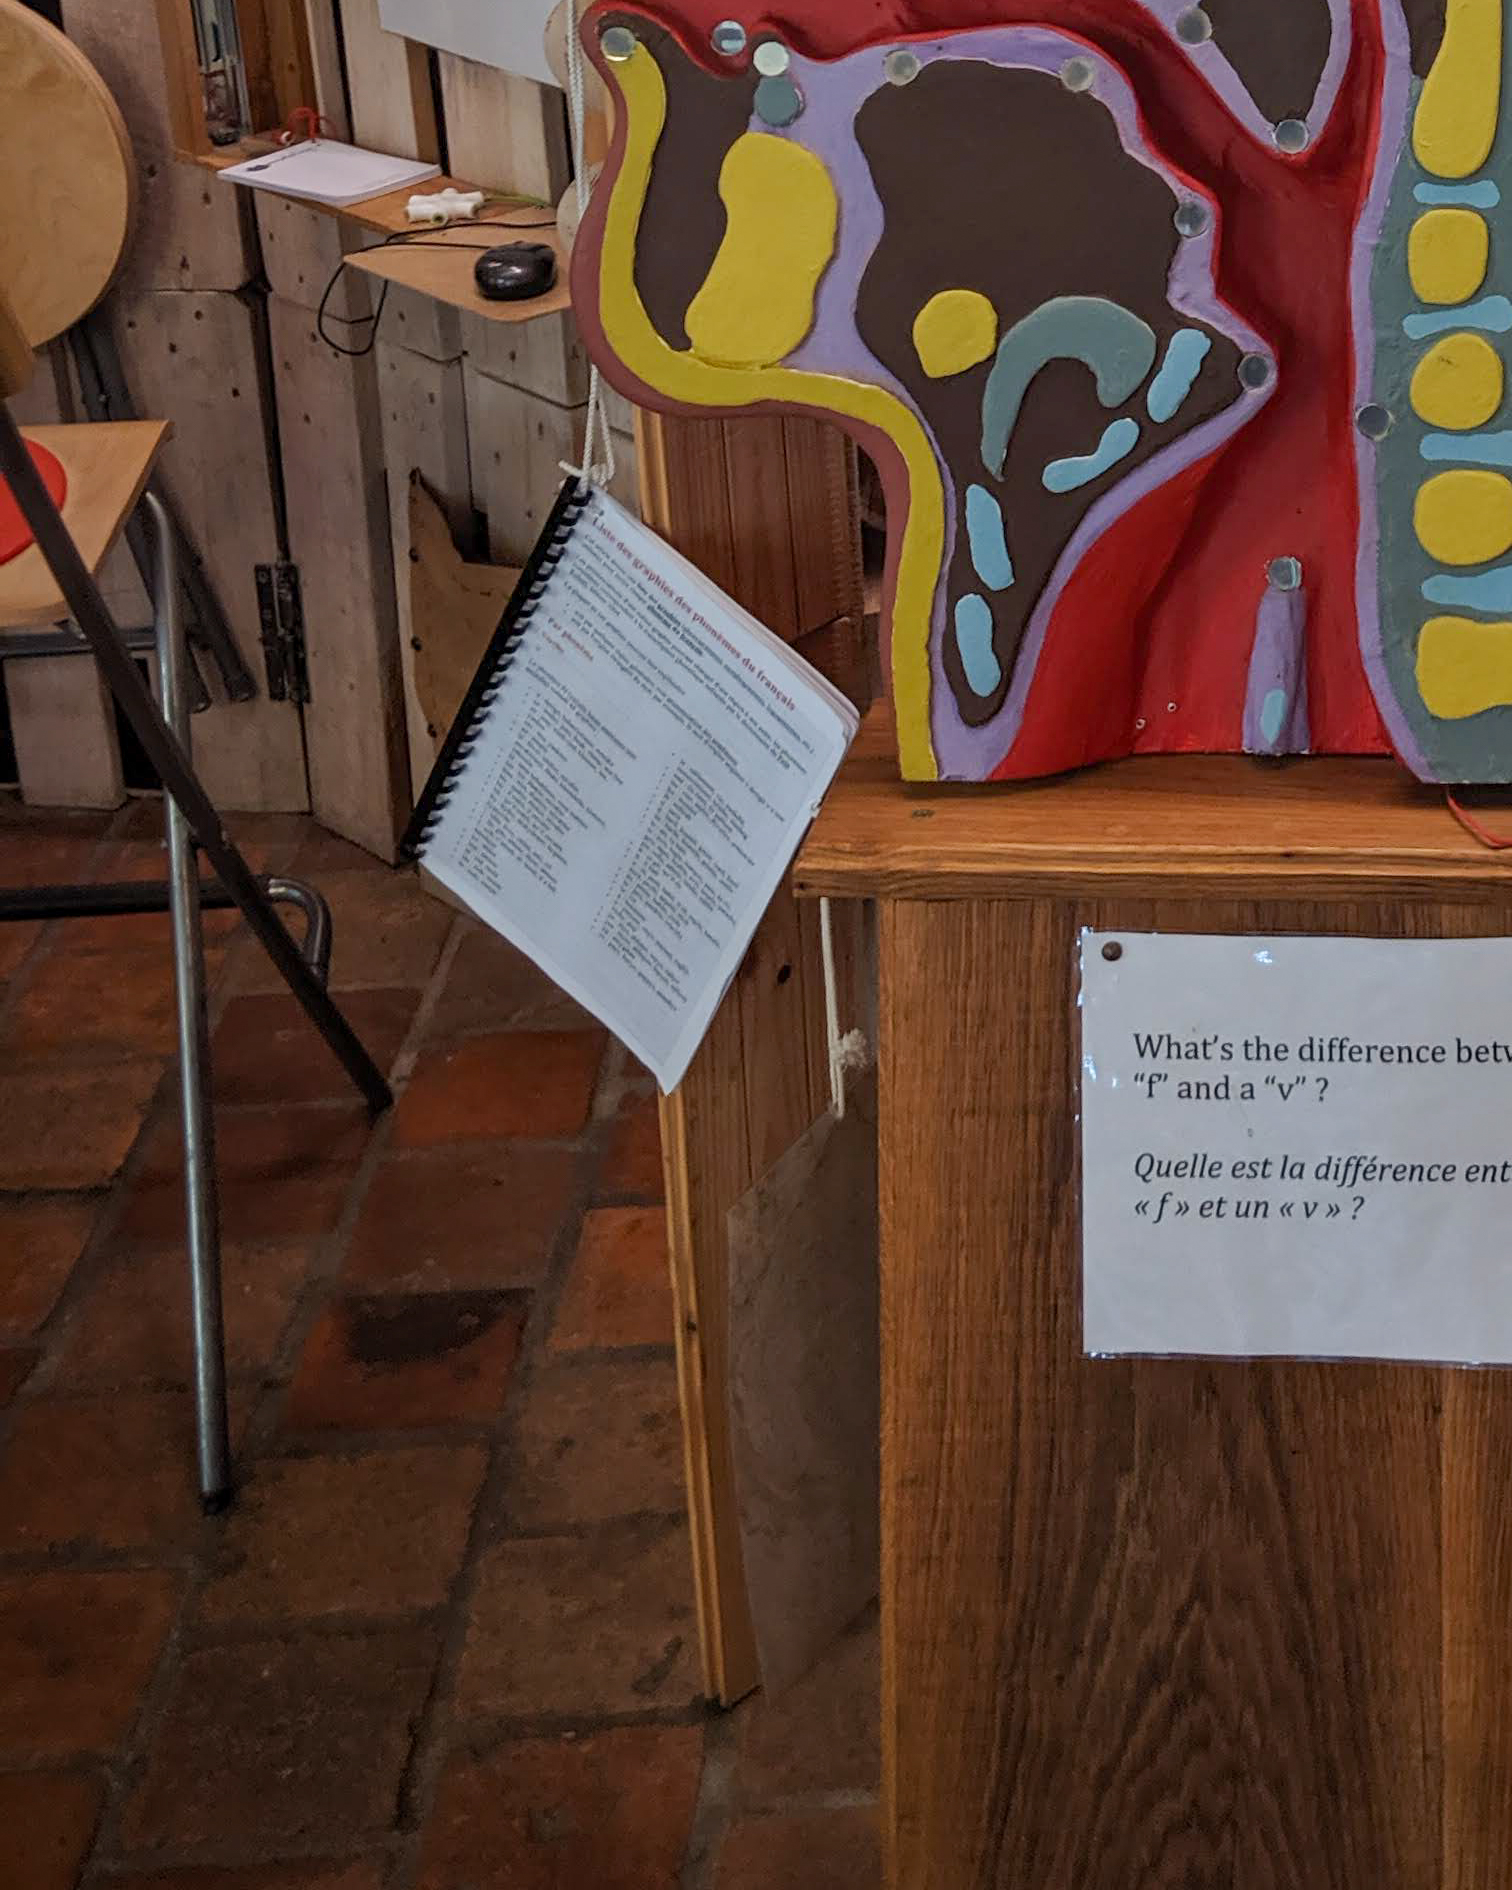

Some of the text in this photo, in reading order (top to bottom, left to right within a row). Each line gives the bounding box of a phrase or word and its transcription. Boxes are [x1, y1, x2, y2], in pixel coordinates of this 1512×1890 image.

[1243, 1037, 1290, 1063] the
[1298, 1037, 1447, 1065] difference
[1177, 1075, 1231, 1101] and
[1240, 1080, 1256, 1101] a
[1315, 1077, 1330, 1103] ?
[1134, 1153, 1223, 1183] Quelle
[1231, 1157, 1273, 1181] est
[1280, 1155, 1306, 1181] la
[1314, 1155, 1457, 1189] différence
[1199, 1194, 1366, 1221] et un ?
